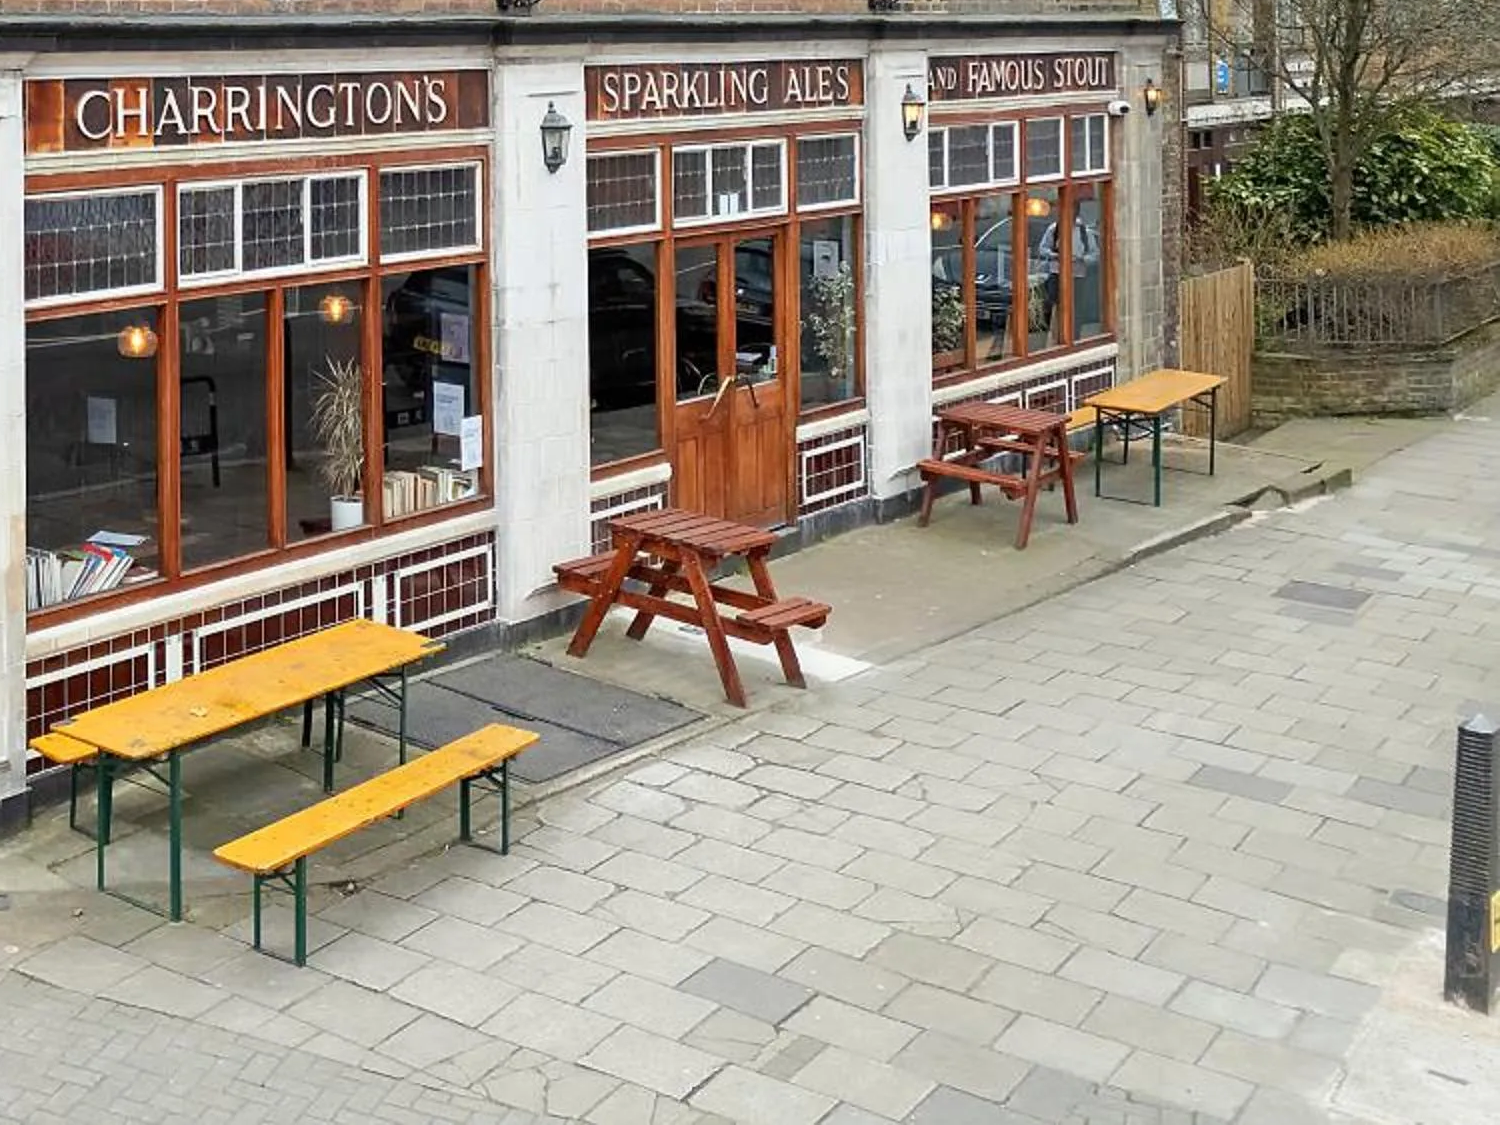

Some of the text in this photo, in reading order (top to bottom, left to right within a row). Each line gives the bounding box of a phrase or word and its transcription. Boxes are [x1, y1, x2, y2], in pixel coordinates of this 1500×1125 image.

[603, 66, 850, 113] SPARKLING ALES
[967, 59, 1045, 93] FAMOUS
[1053, 57, 1109, 88] STOUT
